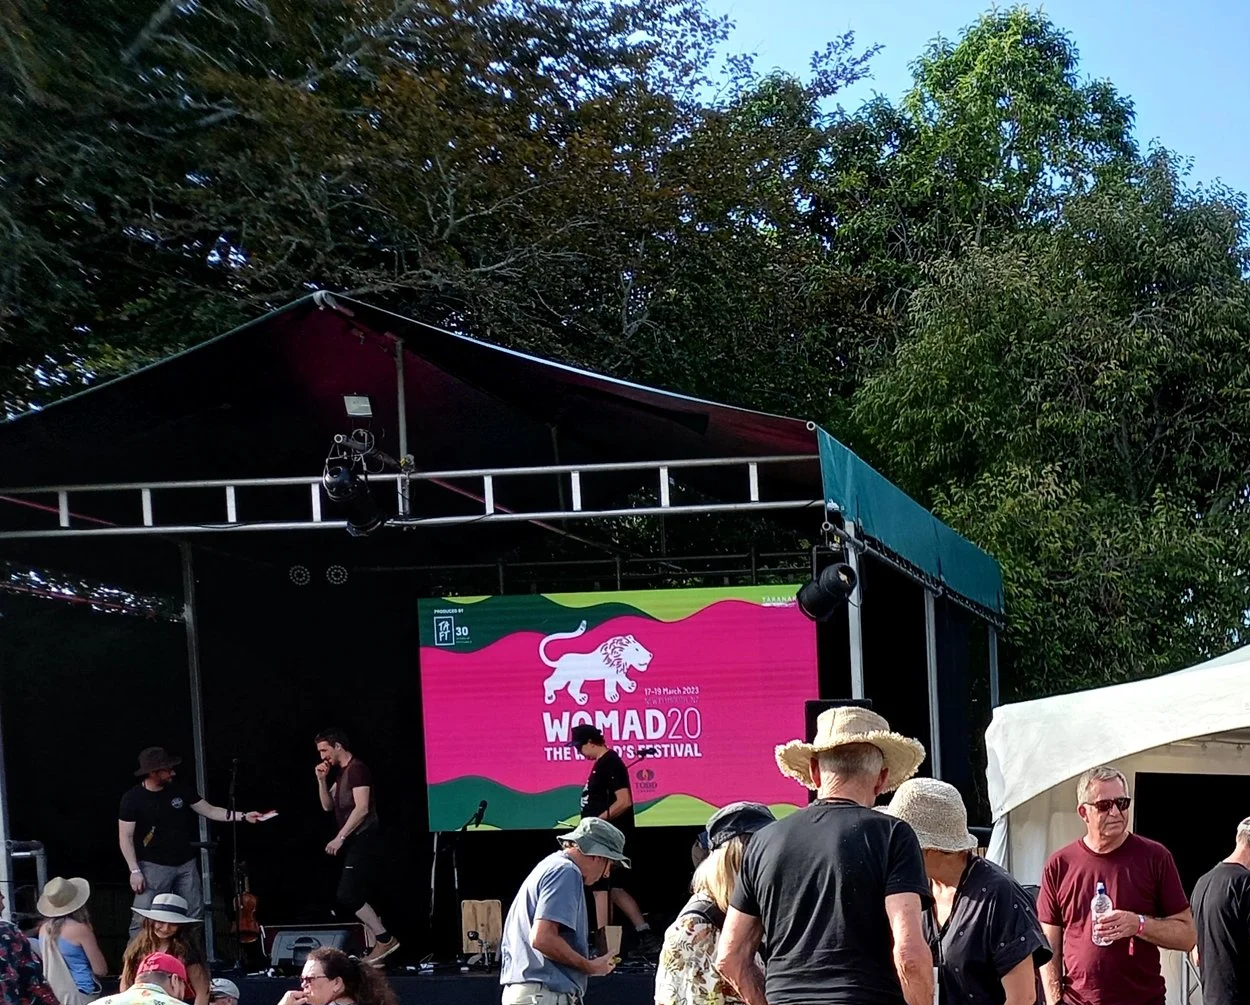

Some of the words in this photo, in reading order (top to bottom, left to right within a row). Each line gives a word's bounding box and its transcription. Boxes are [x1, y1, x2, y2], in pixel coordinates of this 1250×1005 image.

[455, 626, 469, 637] 30
[644, 687, 662, 696] 17-19
[662, 686, 682, 695] March
[682, 685, 700, 695] 2023
[544, 747, 572, 761] THE
[574, 744, 635, 760] WD'S
[638, 743, 702, 758] FESTIVAL
